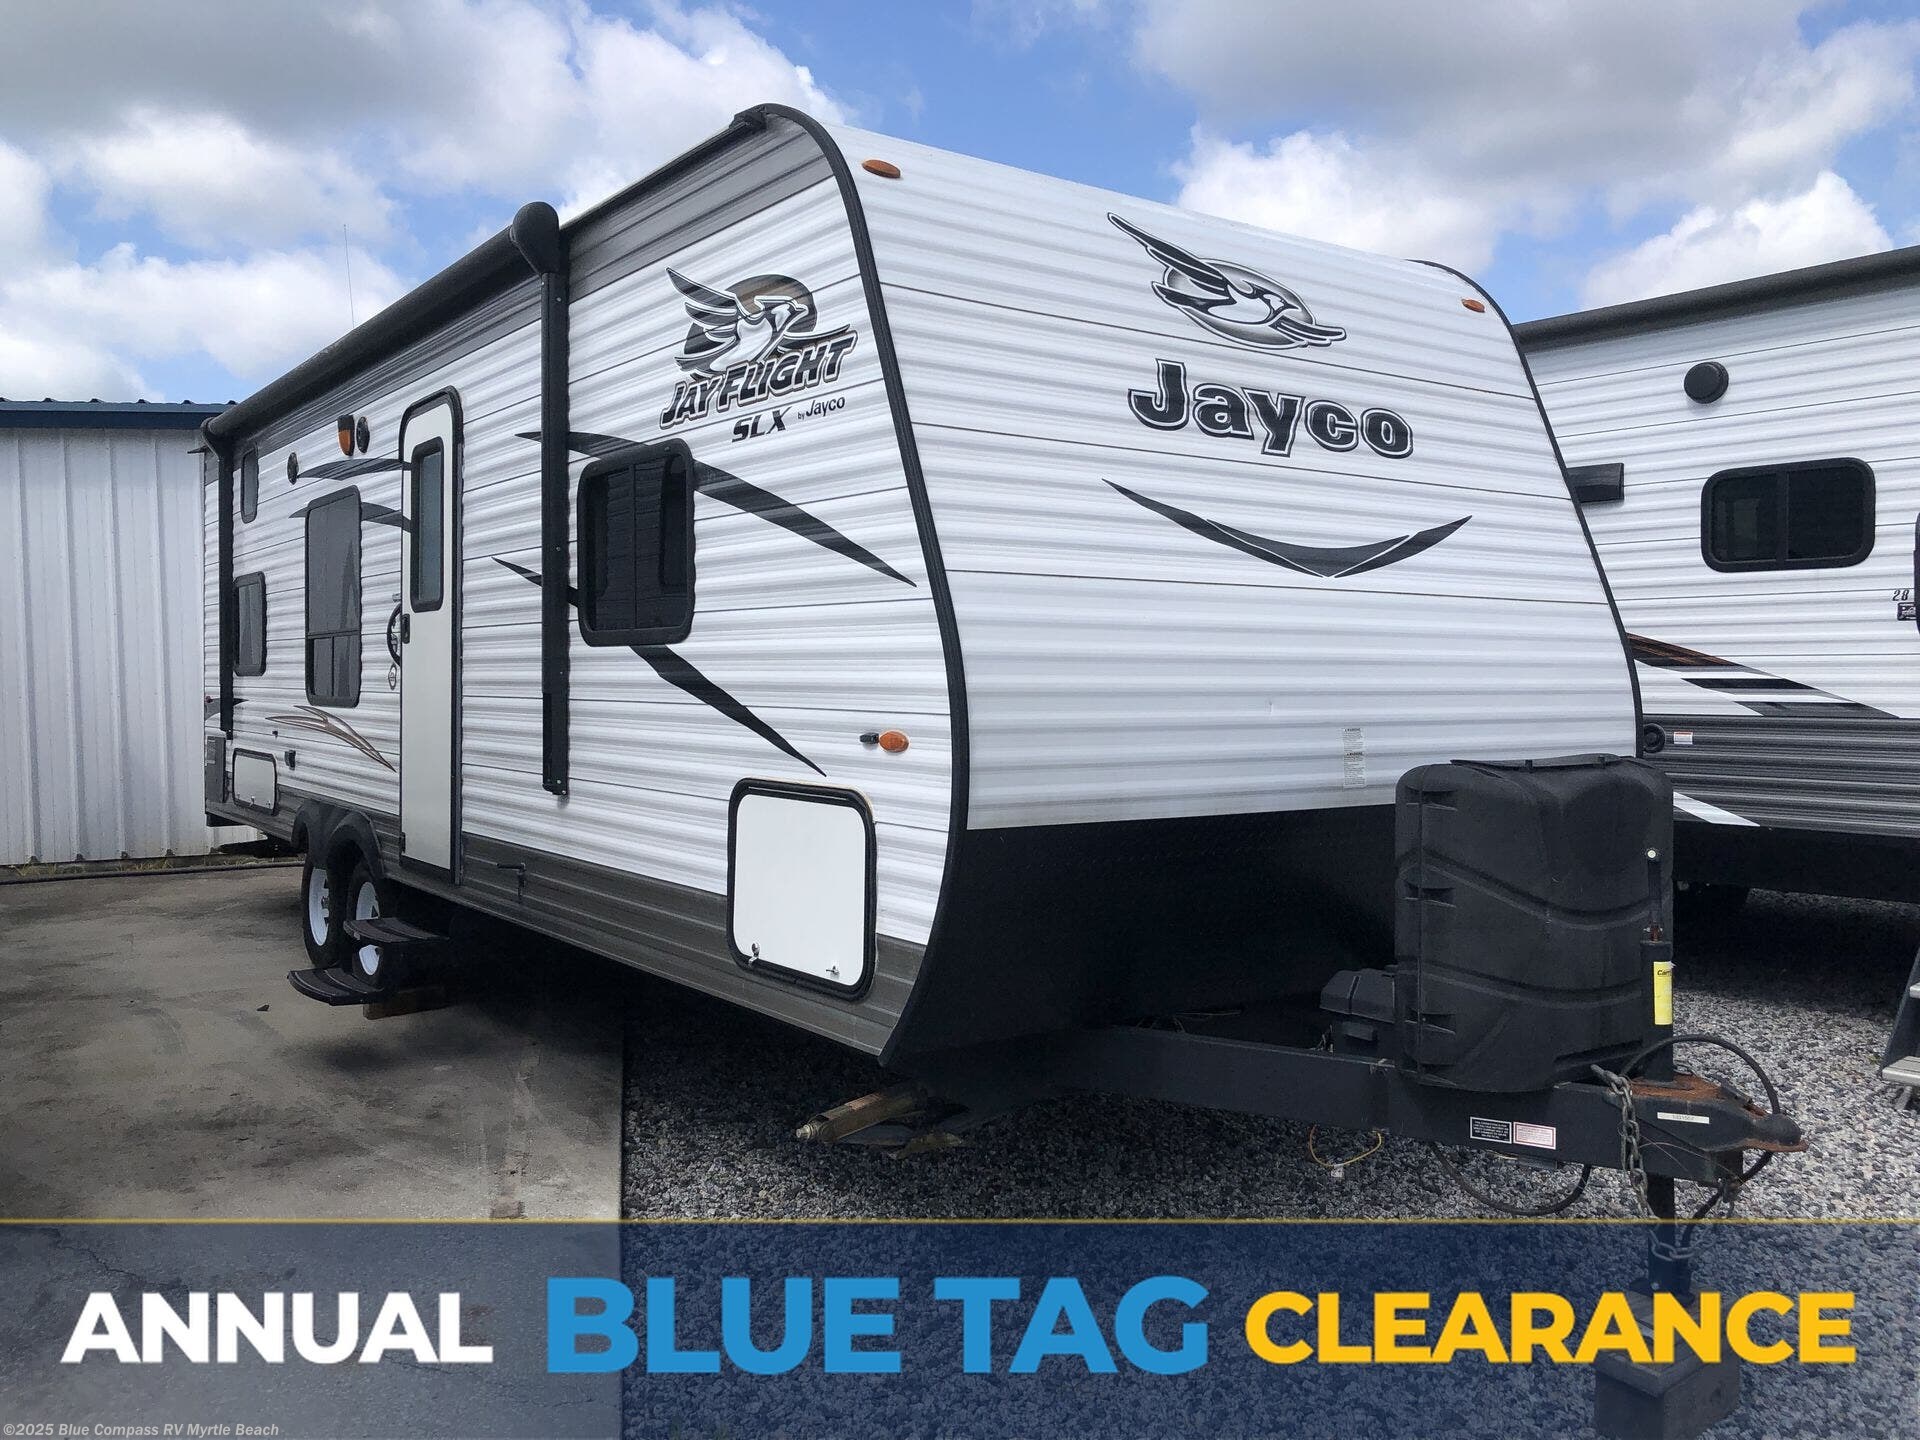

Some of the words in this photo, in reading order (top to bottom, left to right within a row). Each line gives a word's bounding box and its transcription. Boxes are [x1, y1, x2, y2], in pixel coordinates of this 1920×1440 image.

[659, 376, 722, 430] JAY
[716, 329, 858, 413] FLIGHT
[731, 406, 793, 443] SLX
[805, 396, 845, 417] Jayco
[1127, 358, 1414, 459] Jayco
